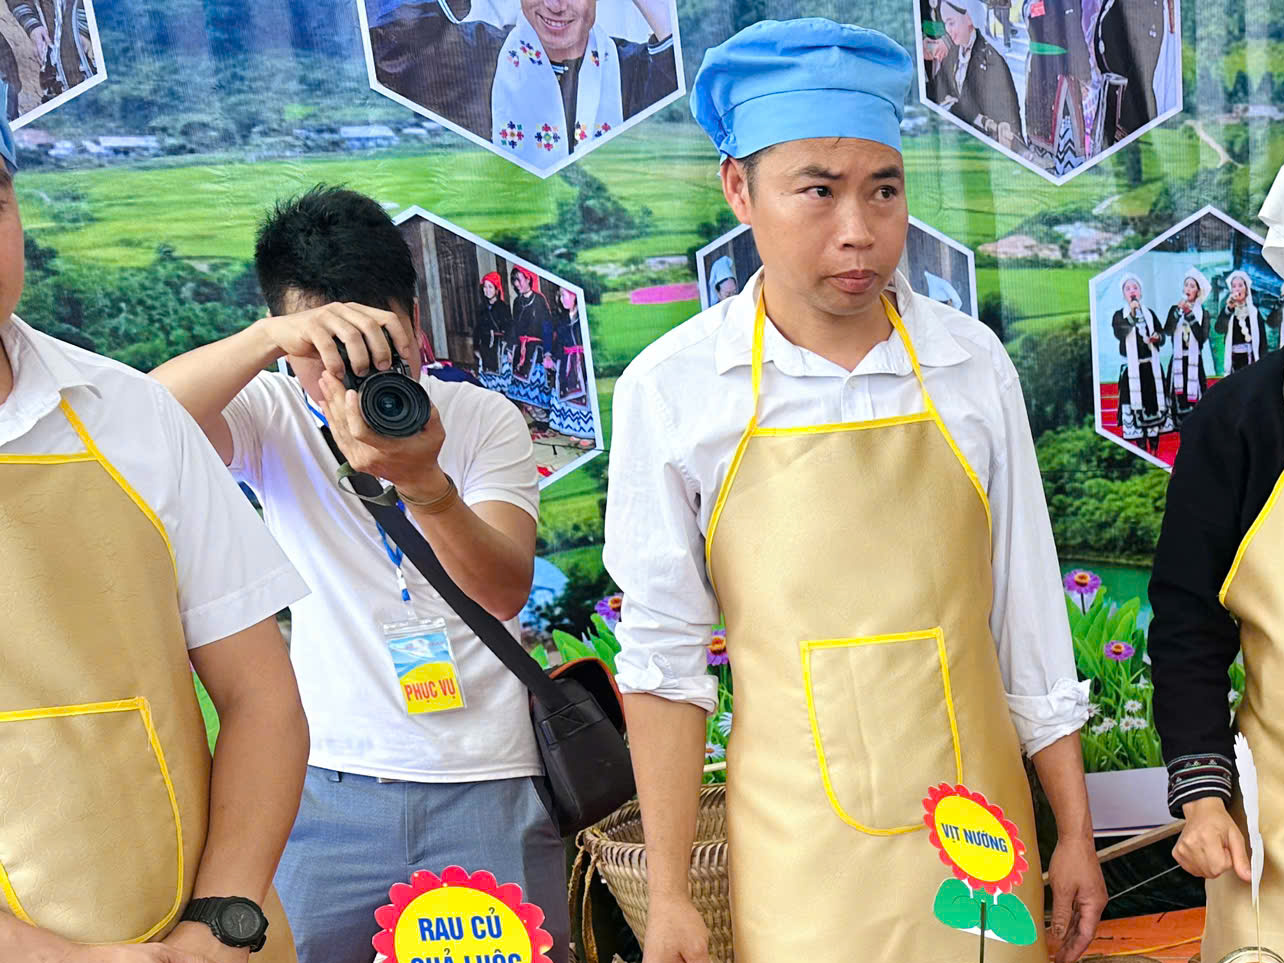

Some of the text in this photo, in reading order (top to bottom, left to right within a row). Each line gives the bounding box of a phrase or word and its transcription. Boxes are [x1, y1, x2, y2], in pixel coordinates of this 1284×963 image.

[404, 677, 457, 703] PHỤC VỤ
[941, 822, 1009, 854] VỊT NƯỚNG
[418, 906, 503, 942] RAU CỦ
